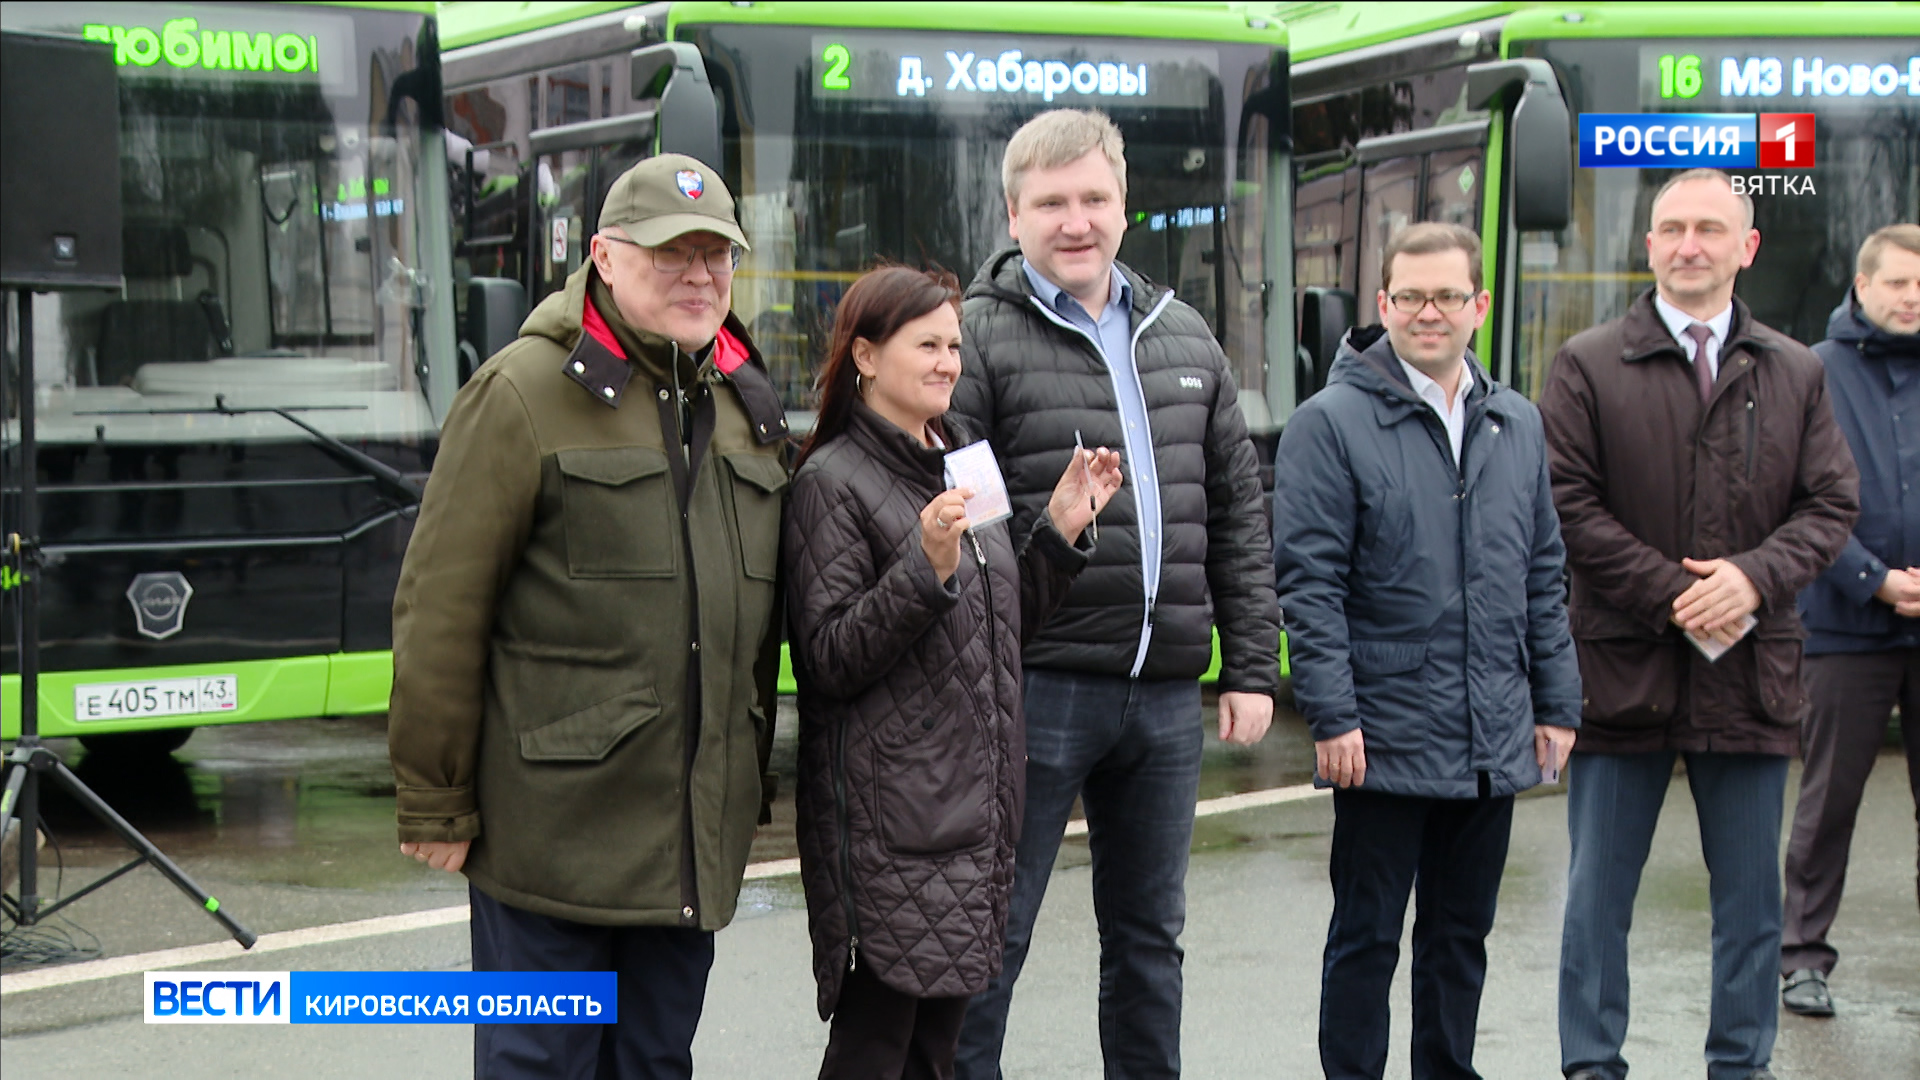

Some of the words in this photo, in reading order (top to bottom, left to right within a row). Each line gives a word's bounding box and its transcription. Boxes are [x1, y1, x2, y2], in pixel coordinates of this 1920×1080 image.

[822, 43, 851, 90] 2
[897, 56, 933, 95] д.
[946, 50, 1147, 101] Хабаровы
[1658, 54, 1702, 98] 16
[203, 679, 227, 700] 43
